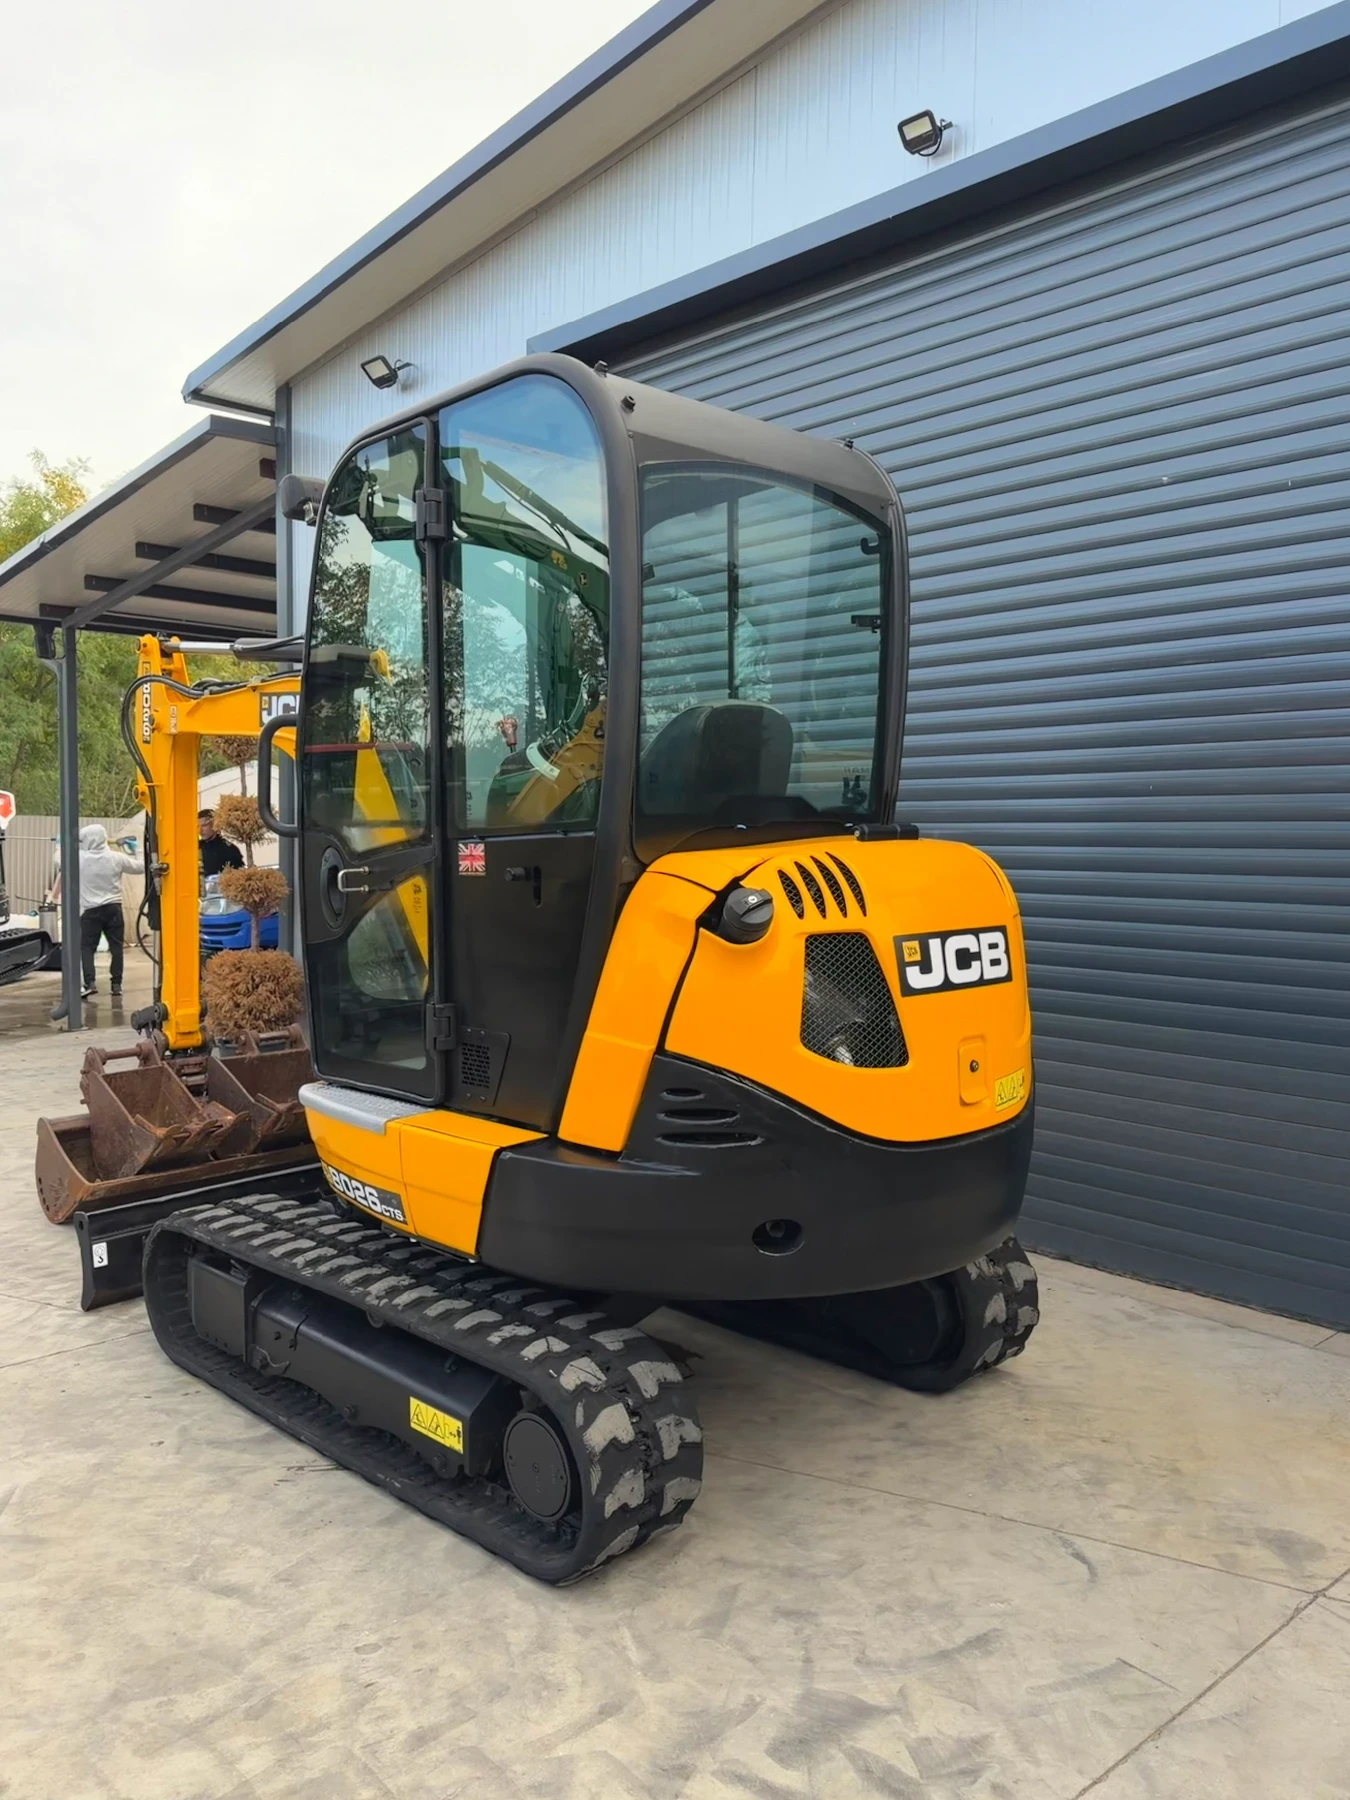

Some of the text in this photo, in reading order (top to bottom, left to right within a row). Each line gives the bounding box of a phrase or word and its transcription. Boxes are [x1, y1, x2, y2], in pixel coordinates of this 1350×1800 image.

[905, 931, 1009, 990] JCB
[328, 1165, 382, 1213] 8026
[381, 1204, 404, 1221] CTS
